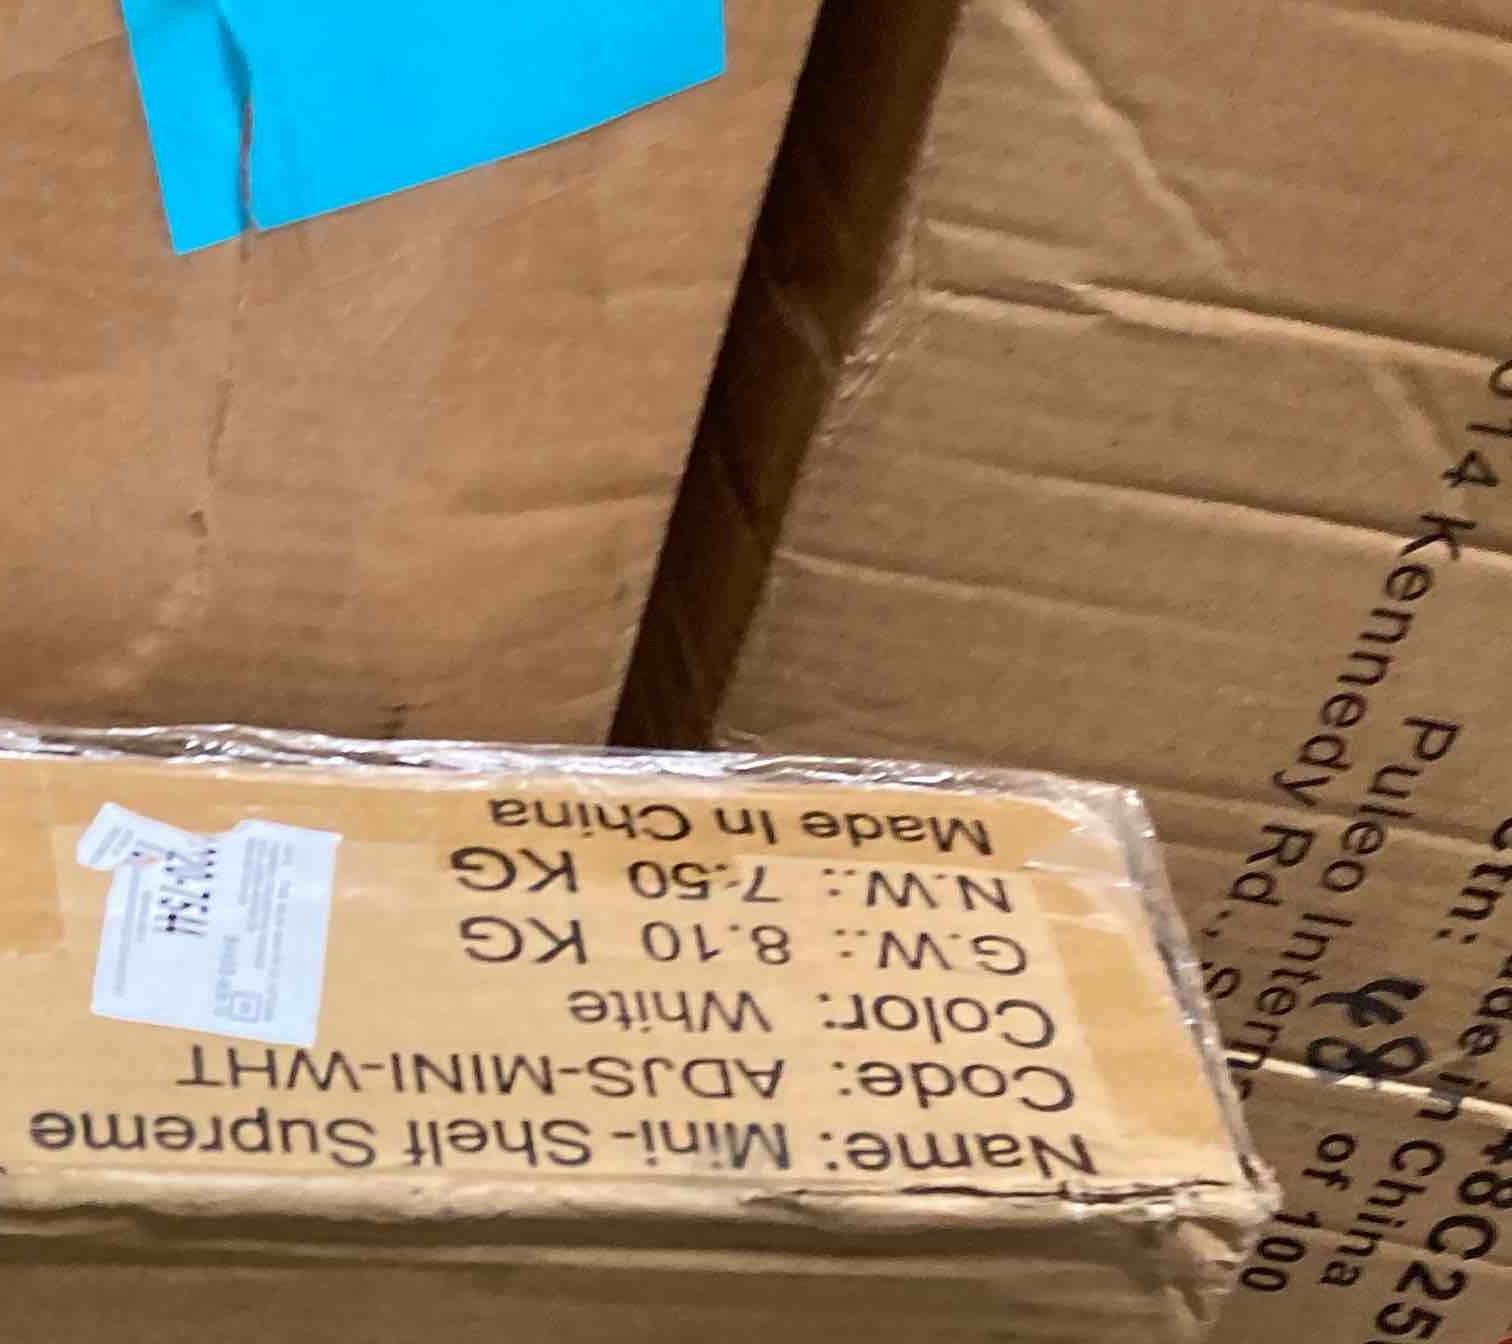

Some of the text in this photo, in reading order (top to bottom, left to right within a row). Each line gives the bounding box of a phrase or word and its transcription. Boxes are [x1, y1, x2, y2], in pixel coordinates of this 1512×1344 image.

[1273, 511, 1477, 806] Kennedy
[490, 798, 993, 856] Made In China
[1322, 716, 1460, 893] Puleo
[450, 846, 578, 894] KG
[821, 867, 1014, 913] N.W.:
[459, 915, 1028, 976] G.W.: 8.10 KG
[567, 989, 1056, 1049] Color: White
[176, 1044, 1075, 1112] Code: ADJS-MINI-WHT
[1417, 1070, 1490, 1121] in
[29, 1106, 377, 1168] Supreme
[820, 1131, 1098, 1179] Name:
[1240, 1134, 1358, 1293] of 100
[1320, 1138, 1445, 1288] China
